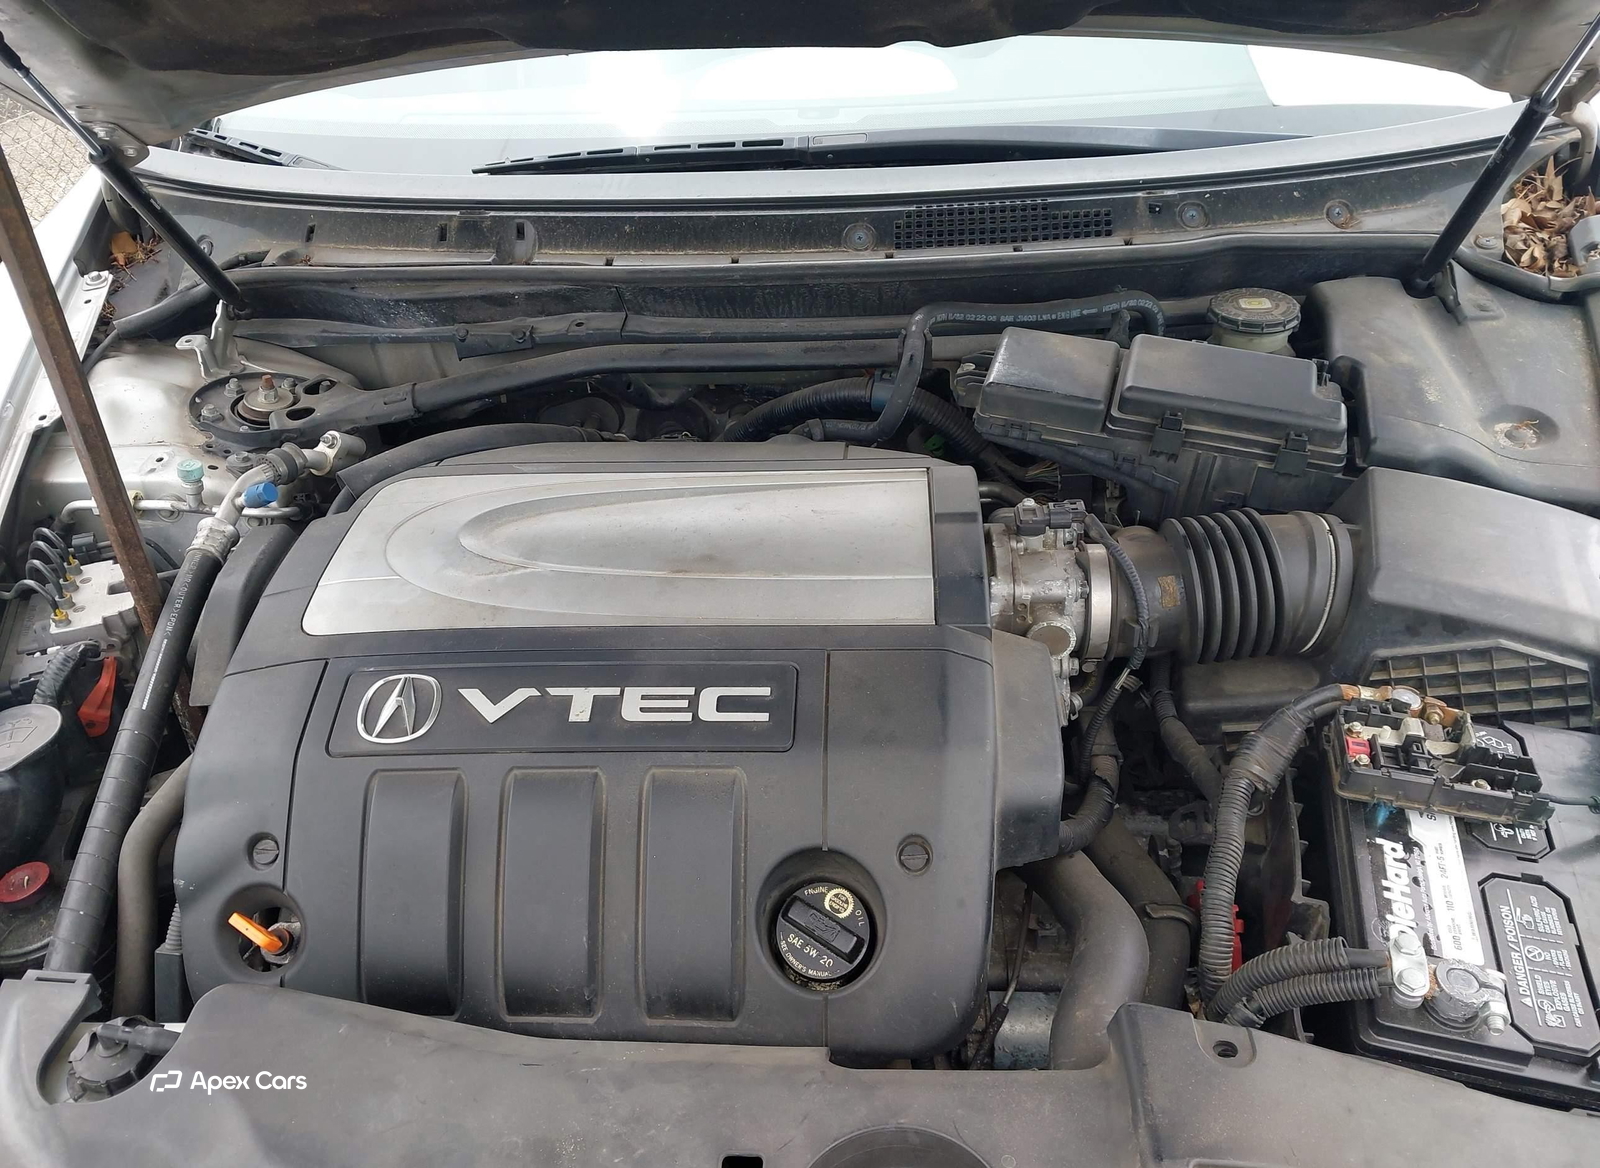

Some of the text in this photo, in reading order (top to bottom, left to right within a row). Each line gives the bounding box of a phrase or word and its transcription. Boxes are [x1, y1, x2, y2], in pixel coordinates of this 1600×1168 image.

[458, 686, 771, 724] VTEC
[804, 886, 865, 927] ENGINE OIL
[787, 933, 804, 949] SAE
[1451, 935, 1462, 950] 600
[1534, 975, 1545, 995] SHIELD
[1550, 979, 1563, 1011] EXPLOSIVE
[1560, 993, 1570, 1012] GASES
